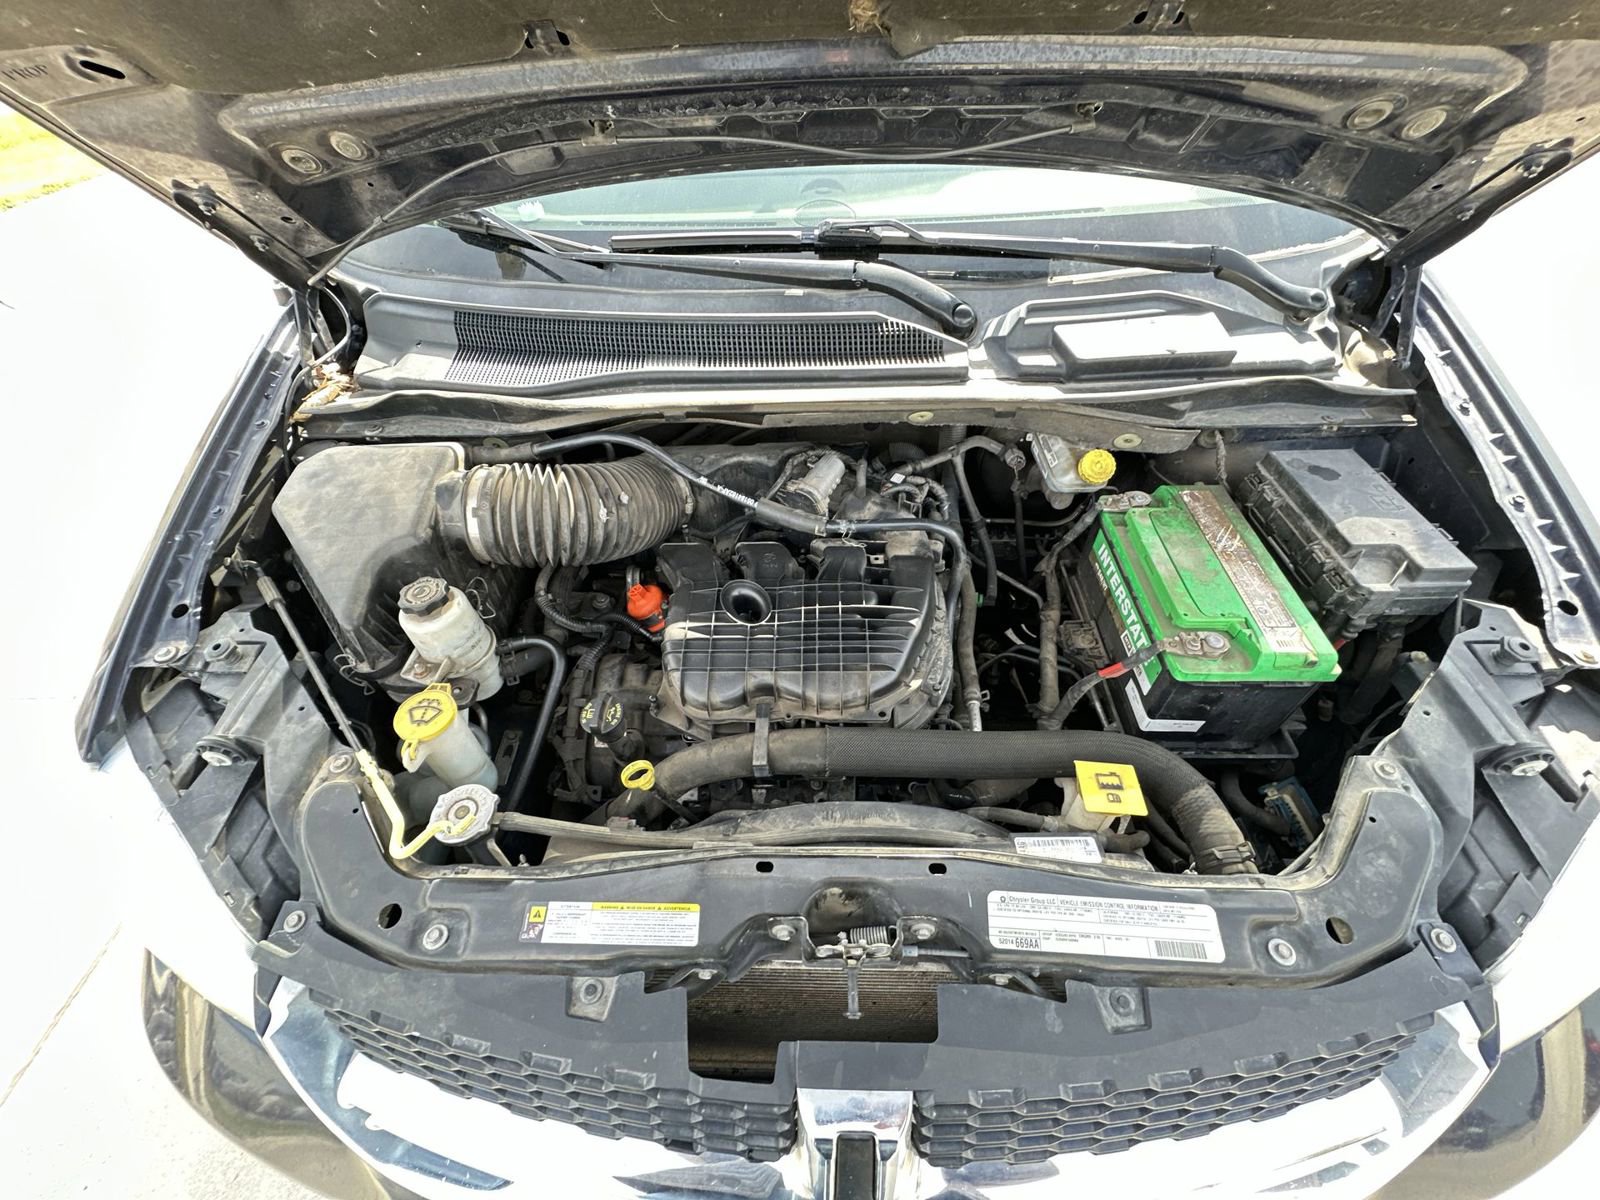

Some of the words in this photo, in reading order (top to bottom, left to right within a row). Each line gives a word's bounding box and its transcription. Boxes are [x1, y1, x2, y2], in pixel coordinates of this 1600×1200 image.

[1098, 543, 1155, 667] INTERSTAT
[1009, 895, 1030, 904] Chrysler
[1031, 897, 1046, 905] Group
[1080, 900, 1103, 908] EMISSION
[1126, 903, 1159, 912] INFORMATION
[1015, 937, 1040, 949] 669AA
